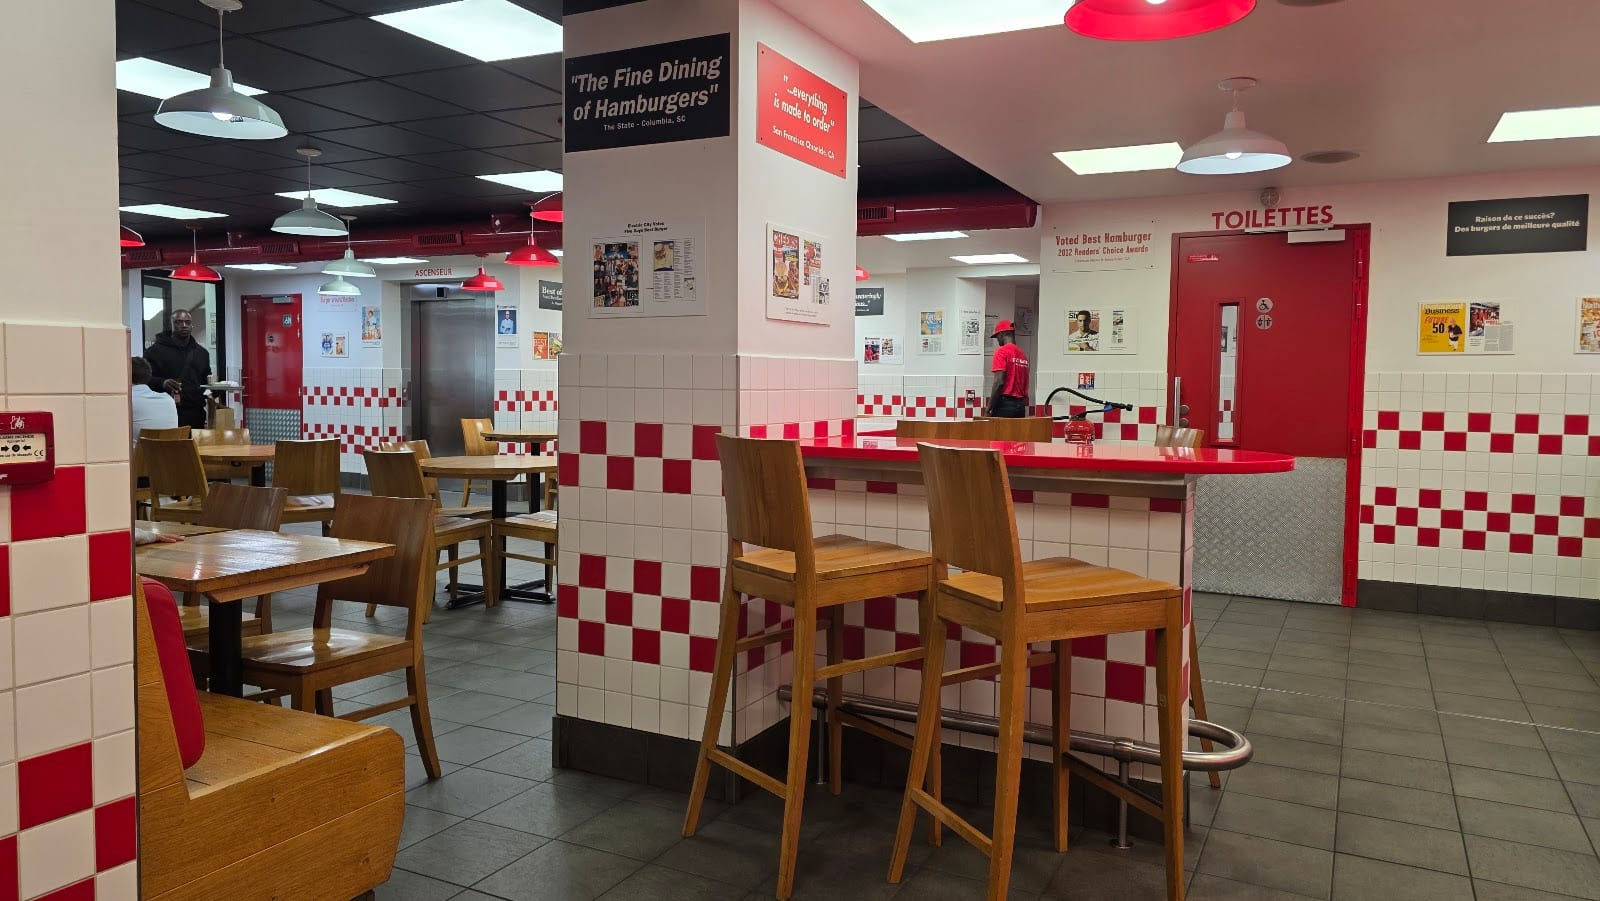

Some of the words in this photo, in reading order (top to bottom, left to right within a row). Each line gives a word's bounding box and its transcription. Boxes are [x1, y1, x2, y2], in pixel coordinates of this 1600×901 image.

[571, 73, 609, 93] "The
[613, 67, 653, 89] Fine
[658, 56, 723, 82] Dining
[573, 100, 592, 121] of
[594, 83, 719, 119] Hamburgers"
[773, 92, 780, 108] is
[781, 101, 802, 119] made
[803, 109, 811, 123] to
[617, 122, 635, 130] State
[641, 117, 675, 127] Columbia,
[772, 125, 783, 137] San
[783, 130, 805, 146] Francisco
[827, 150, 835, 160] CA
[1211, 205, 1334, 230] TOILETTES
[1475, 215, 1502, 223] Raison
[1524, 211, 1556, 220] succès?
[1454, 225, 1470, 233] Des
[1470, 224, 1501, 233] burgers
[1513, 221, 1550, 230] meilleure
[1551, 219, 1581, 229] qualité
[1055, 234, 1079, 246] Voted
[1082, 233, 1102, 244] Best
[1104, 232, 1152, 244] Hamburger
[1057, 248, 1073, 257] 2012
[1074, 246, 1101, 256] Readers'
[1102, 246, 1124, 255] Choice
[1125, 245, 1149, 253] Awards
[415, 267, 453, 277] ASCENSEUR
[542, 286, 556, 296] Best
[1432, 323, 1445, 334] 50
